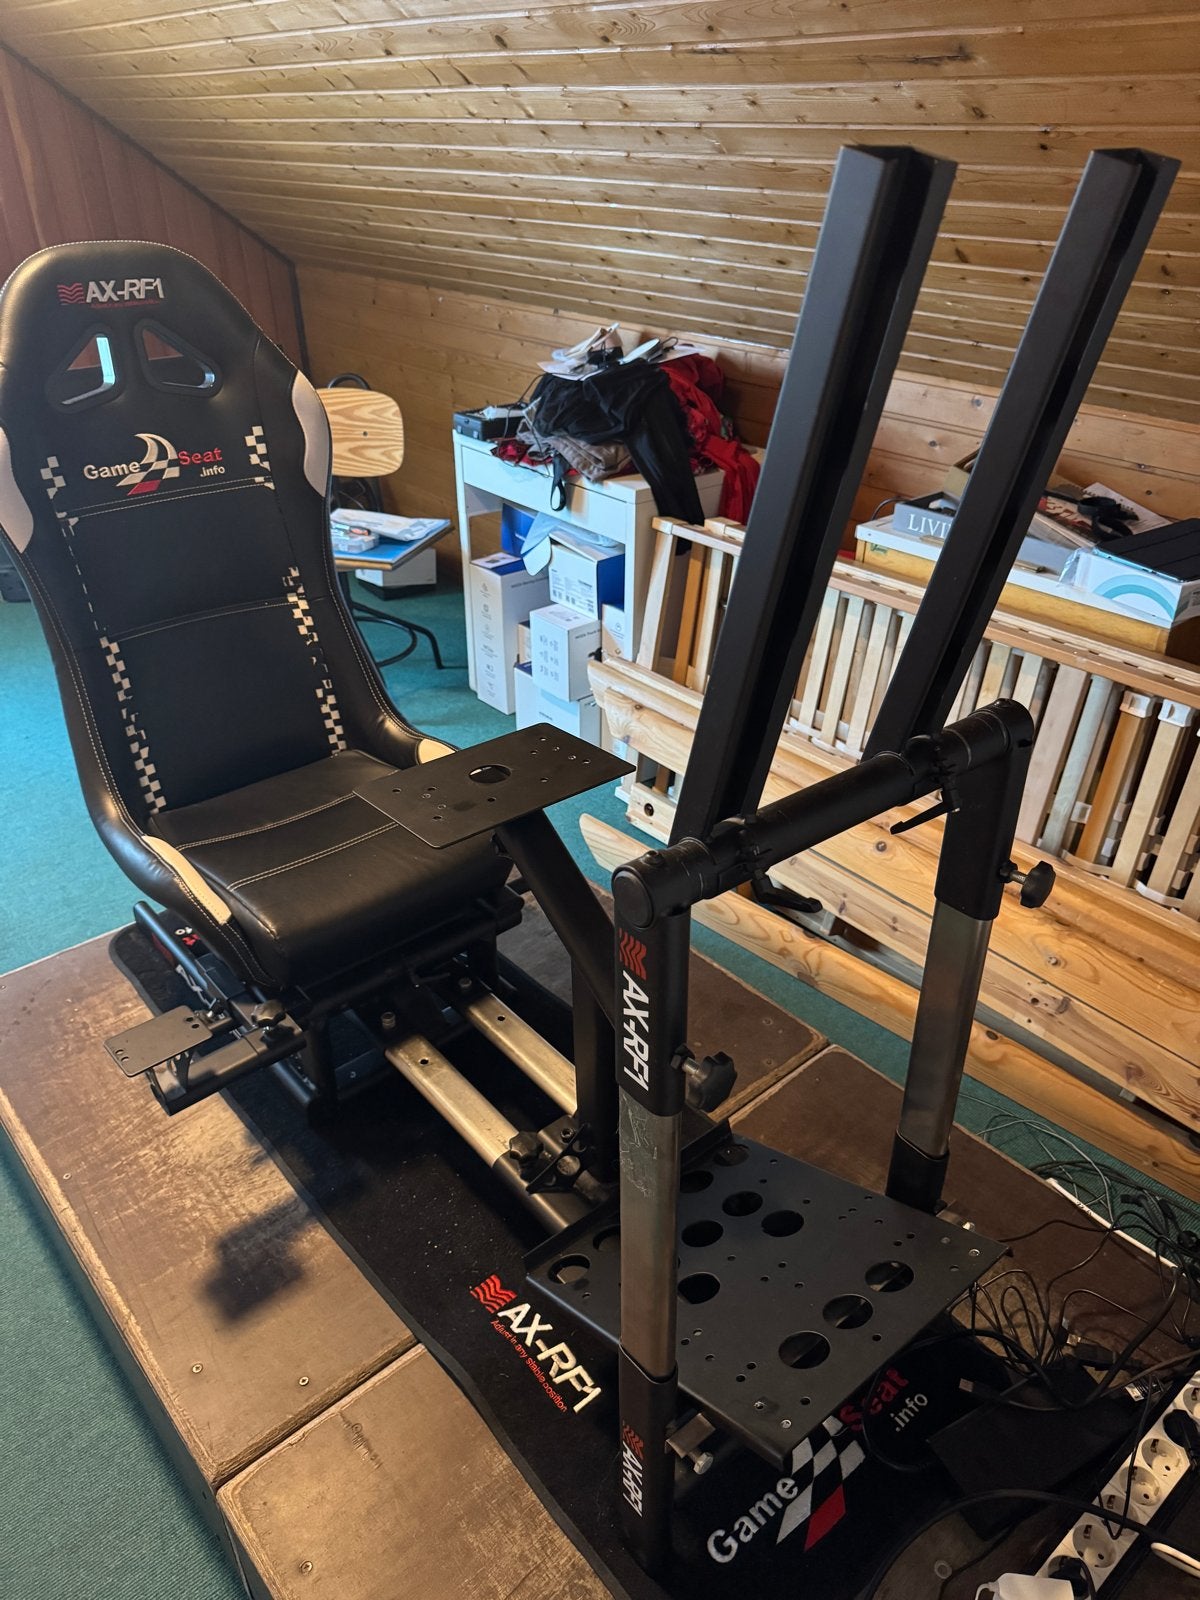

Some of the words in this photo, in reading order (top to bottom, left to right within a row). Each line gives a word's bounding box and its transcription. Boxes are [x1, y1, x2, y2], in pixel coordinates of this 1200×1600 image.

[86, 277, 166, 304] AX-RF1
[83, 459, 141, 480] Game
[177, 448, 223, 466] Seat
[200, 464, 226, 478] .info
[907, 513, 952, 539] LIVI
[622, 970, 650, 1091] AX-RF1
[497, 1302, 602, 1413] AX-RF1
[515, 1343, 528, 1358] any
[525, 1357, 546, 1383] stable
[889, 1393, 928, 1432] .info
[622, 1441, 643, 1518] AX-RF1
[706, 1477, 799, 1564] Game
